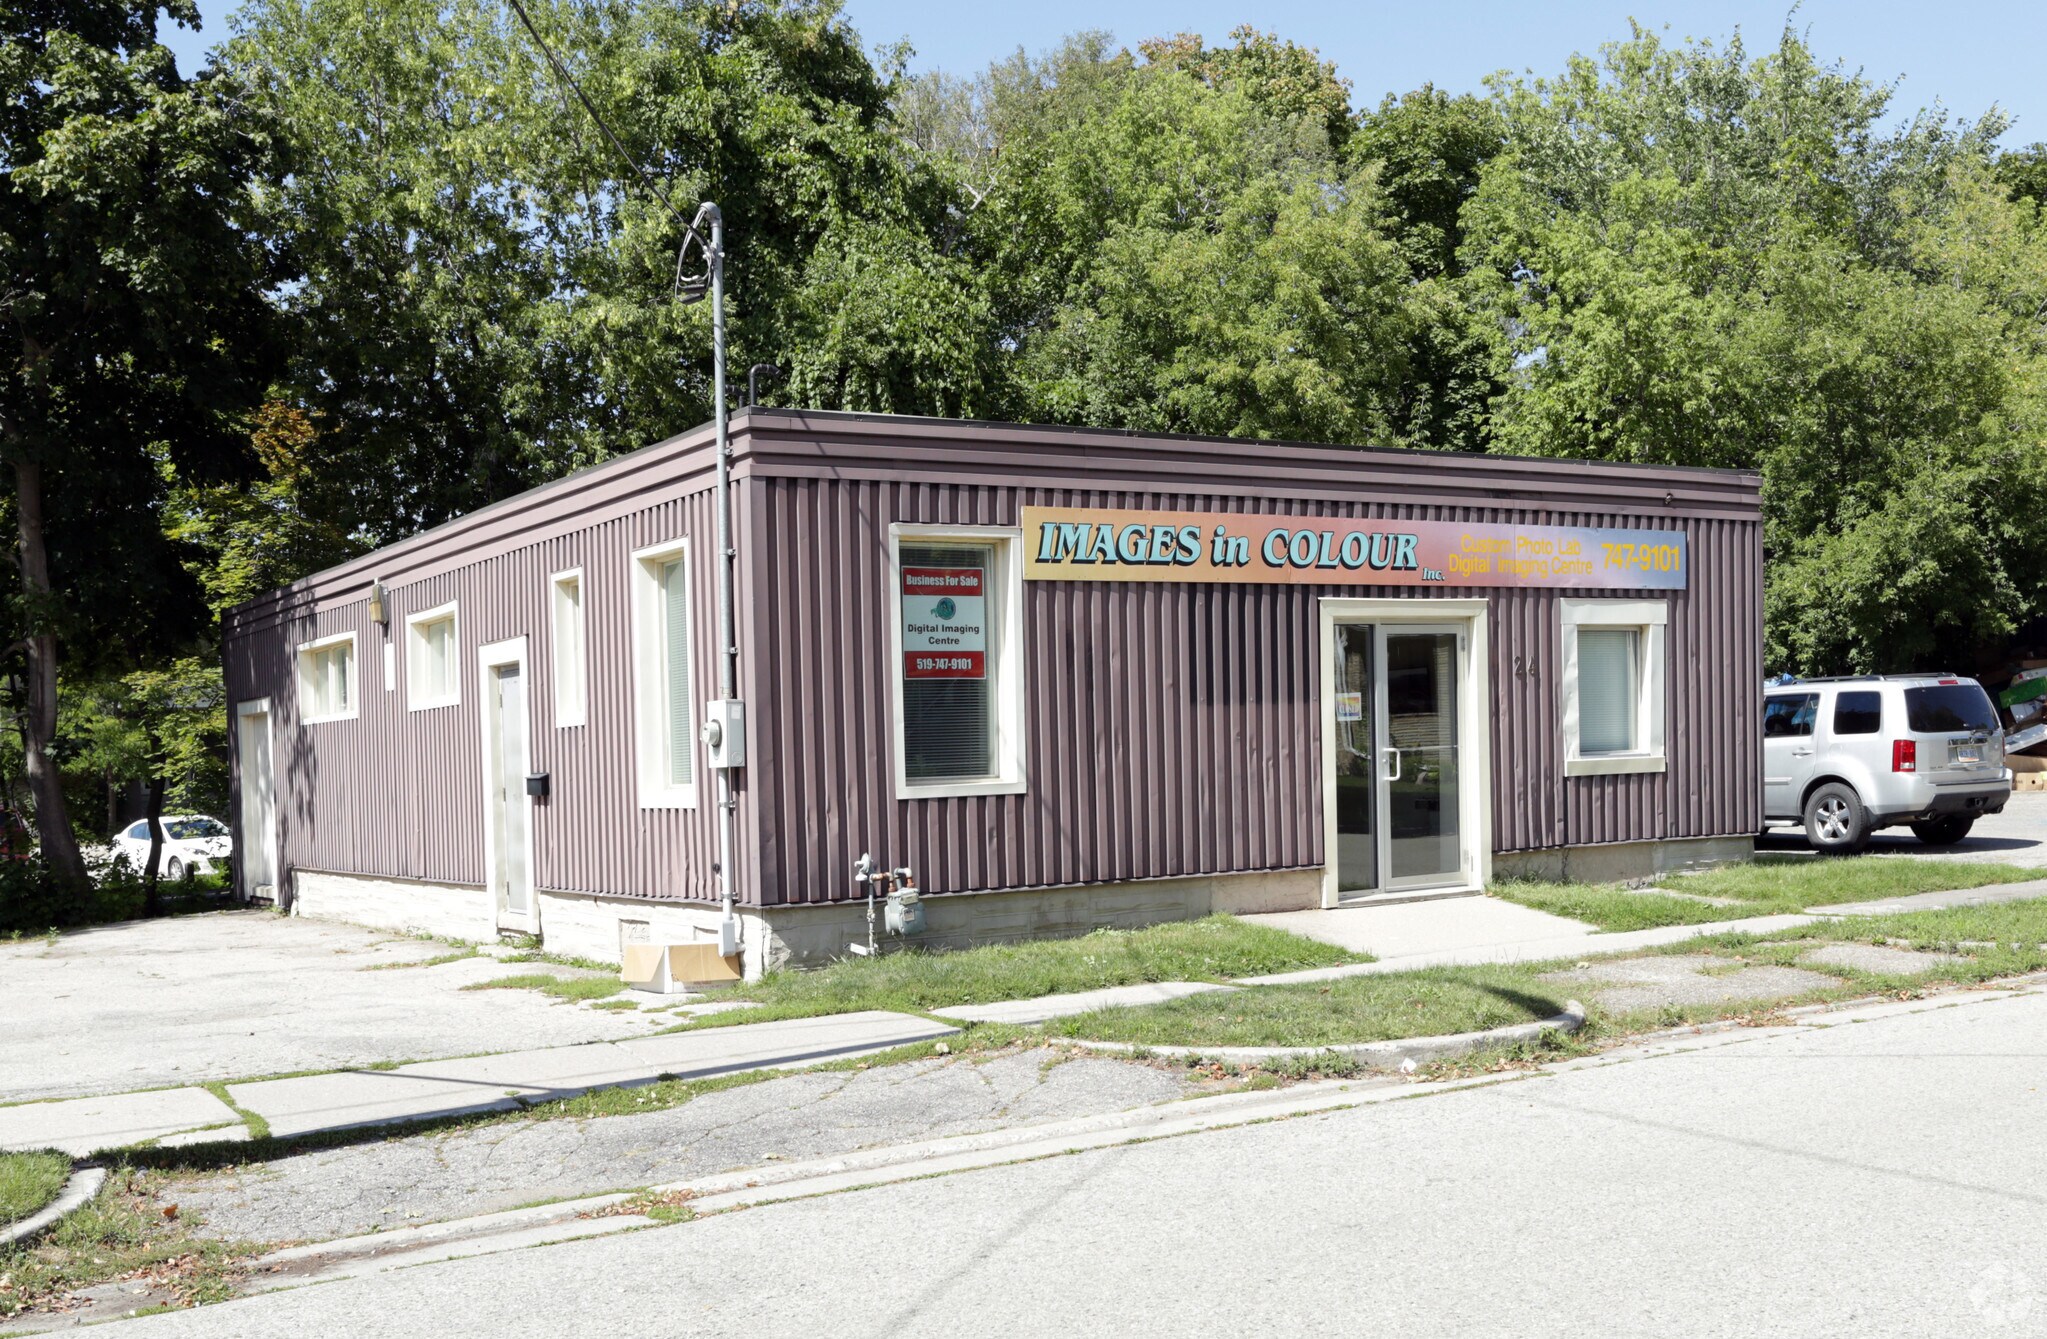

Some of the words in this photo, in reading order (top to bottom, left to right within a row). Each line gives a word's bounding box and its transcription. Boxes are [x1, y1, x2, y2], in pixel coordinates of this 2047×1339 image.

[1035, 522, 1202, 566] IMAGES
[1210, 524, 1251, 568] in
[1261, 528, 1419, 570] COLOUR
[1422, 567, 1446, 581] Inc.
[1461, 534, 1512, 553] Custom
[1517, 535, 1553, 555] Photo
[1558, 538, 1581, 555] Lab
[1449, 553, 1490, 577] Digital
[1498, 555, 1548, 579] Imaging
[1552, 556, 1593, 575] Centre
[1602, 543, 1680, 572] 747-9101
[906, 574, 945, 586] Business
[946, 575, 959, 586] For
[960, 575, 979, 587] Sale
[907, 624, 939, 634] Digital
[941, 624, 980, 635] Imaging
[928, 636, 960, 645] Centre
[916, 658, 972, 670] 519-747-9101
